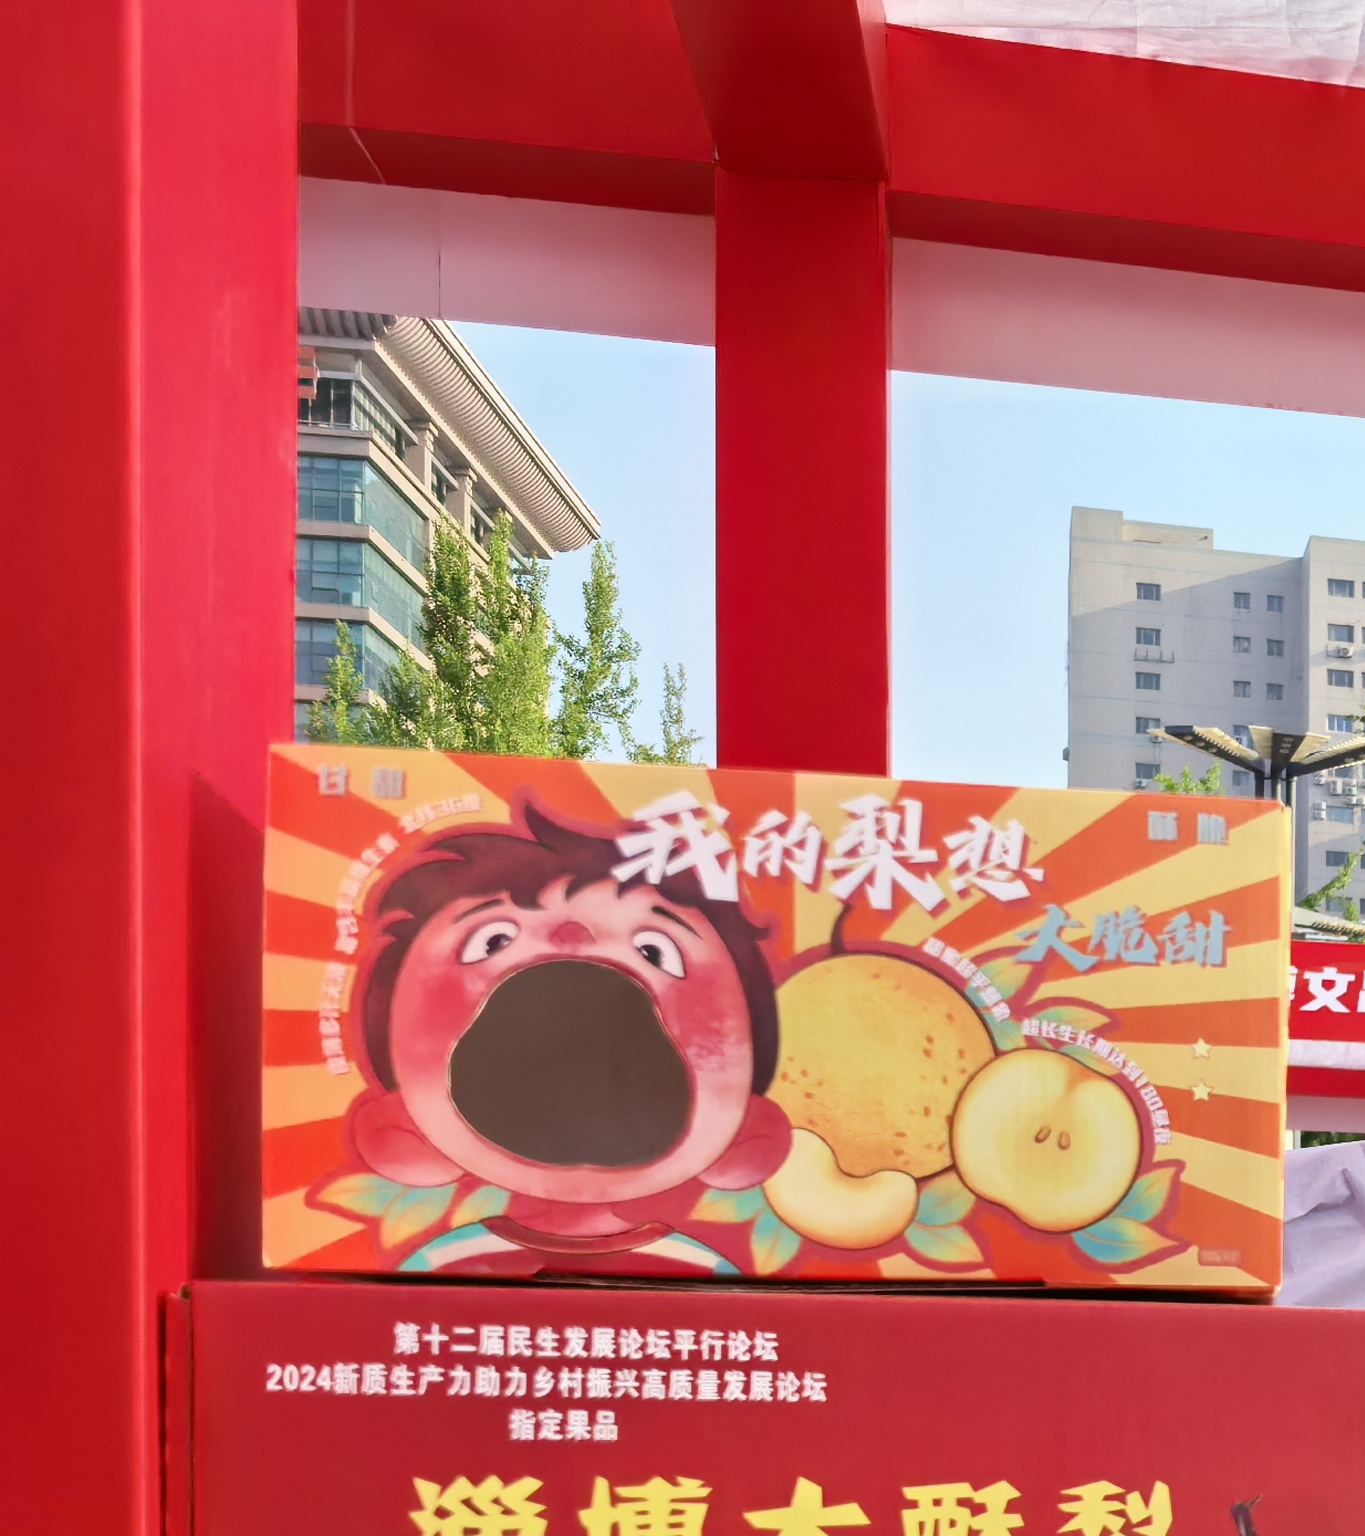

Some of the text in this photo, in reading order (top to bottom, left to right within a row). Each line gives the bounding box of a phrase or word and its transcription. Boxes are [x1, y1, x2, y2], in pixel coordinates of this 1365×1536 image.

[610, 790, 1045, 912] 我的梨想
[1012, 903, 1233, 972] 大脆甜
[393, 1321, 780, 1363] 第十二届民生发展论坛平行论坛
[266, 1361, 828, 1403] 2024新质生产力助力乡村振兴高质量发展论坛
[509, 1408, 620, 1443] 指定果品
